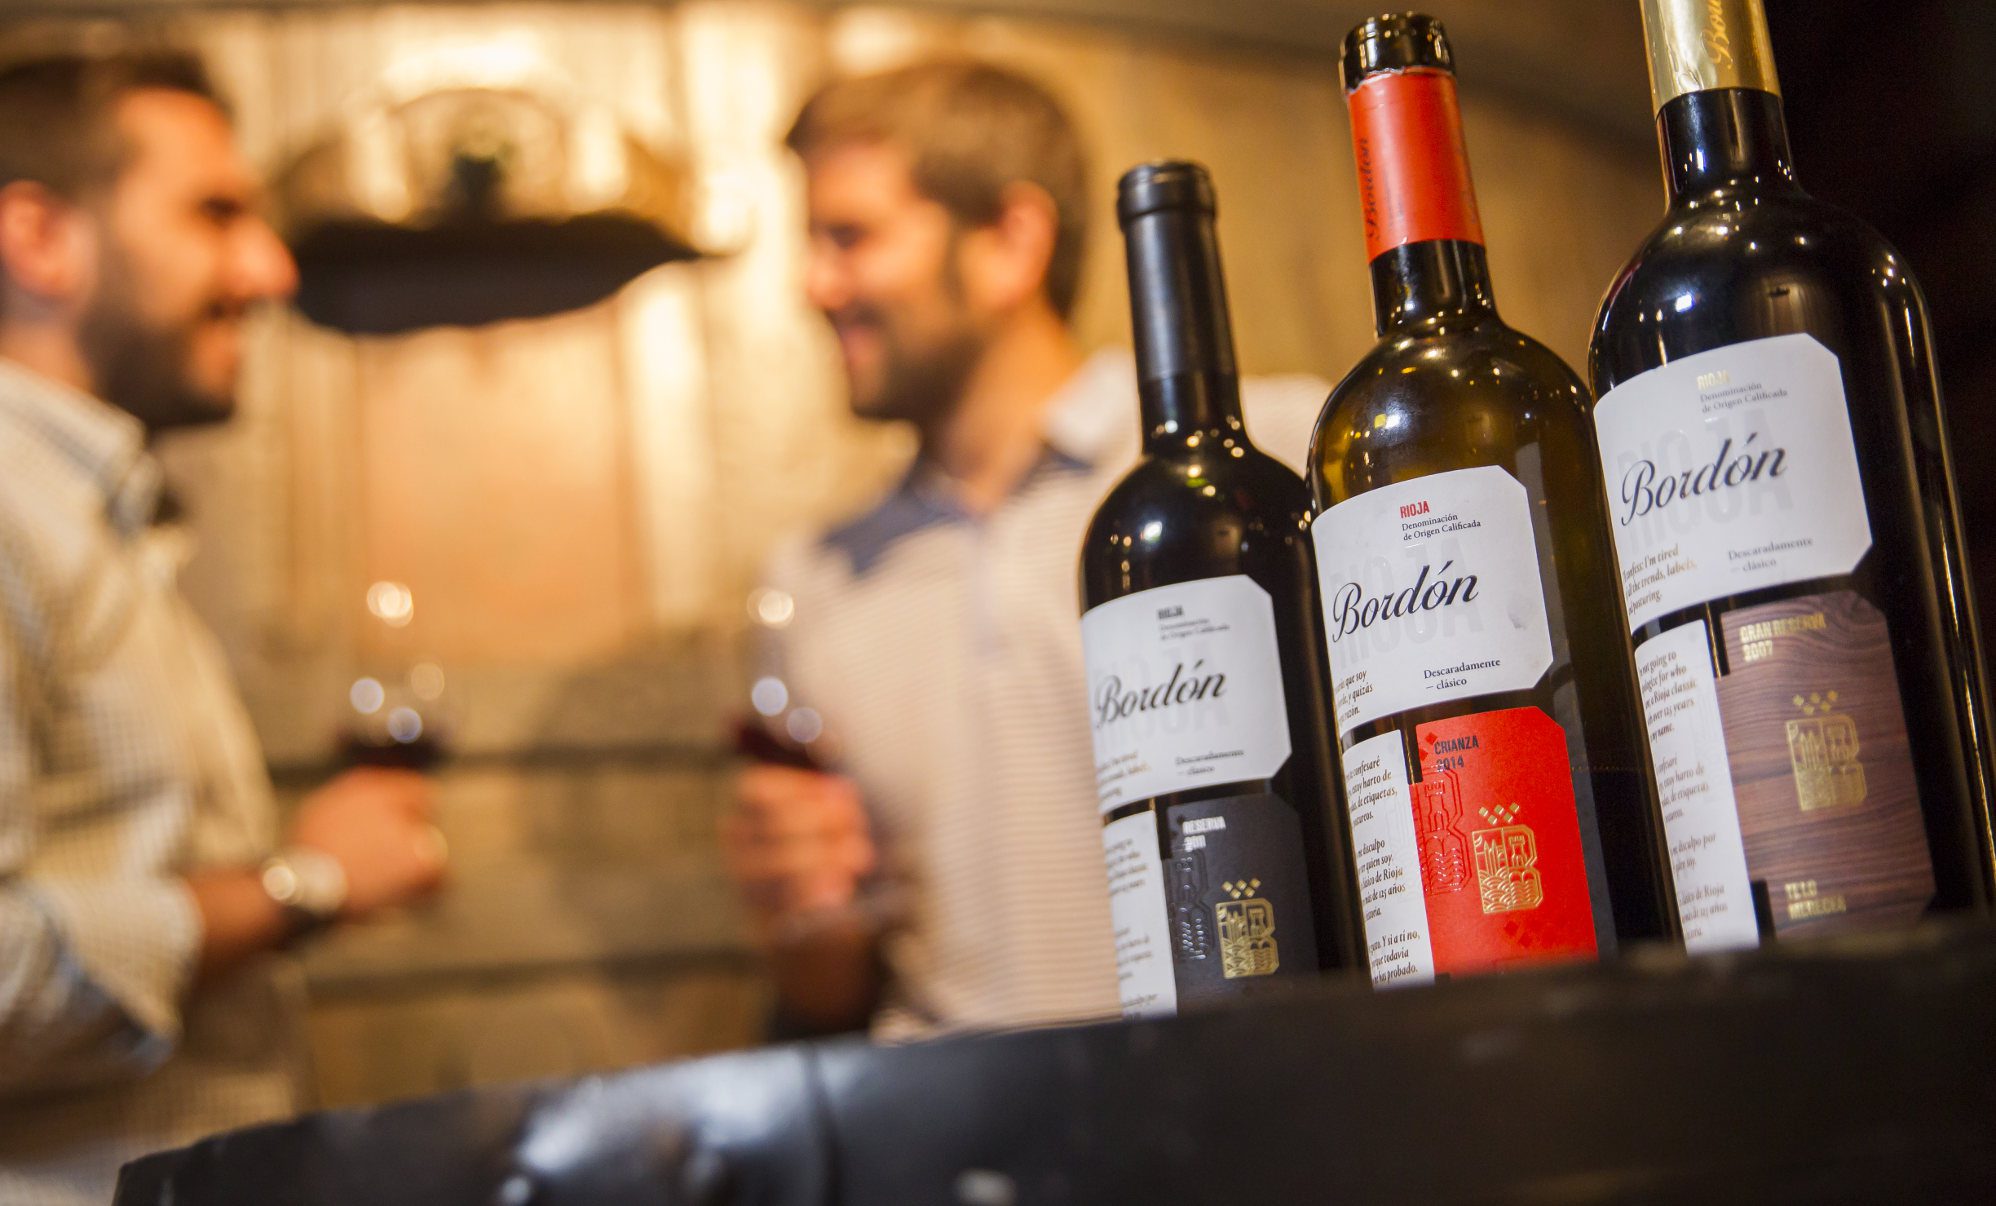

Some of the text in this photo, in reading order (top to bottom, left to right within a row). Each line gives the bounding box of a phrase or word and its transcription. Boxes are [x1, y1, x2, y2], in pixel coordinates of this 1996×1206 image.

[1621, 432, 1787, 526] Bordón
[1400, 500, 1430, 518] RIOJA
[1402, 513, 1458, 531] Denominación
[1403, 519, 1481, 541] de Origen Calificada
[1728, 537, 1814, 560] Descaradamente
[1332, 559, 1479, 643] Bordón
[1740, 621, 1772, 643] GRAN
[1743, 640, 1773, 662] 2007
[1355, 669, 1368, 683] soy
[1424, 659, 1501, 679] Descaradamente
[1352, 682, 1374, 702] quizás
[1436, 677, 1467, 690] clásico
[1097, 659, 1226, 729] Bordón
[1434, 735, 1479, 755] CRIANZA
[1437, 755, 1464, 772] 2014
[1362, 776, 1381, 789] harto
[1382, 769, 1392, 782] de
[1364, 787, 1398, 806] etiquetas,
[1382, 866, 1404, 881] Rioja
[1388, 883, 1406, 895] años
[1387, 961, 1418, 984] probado.
